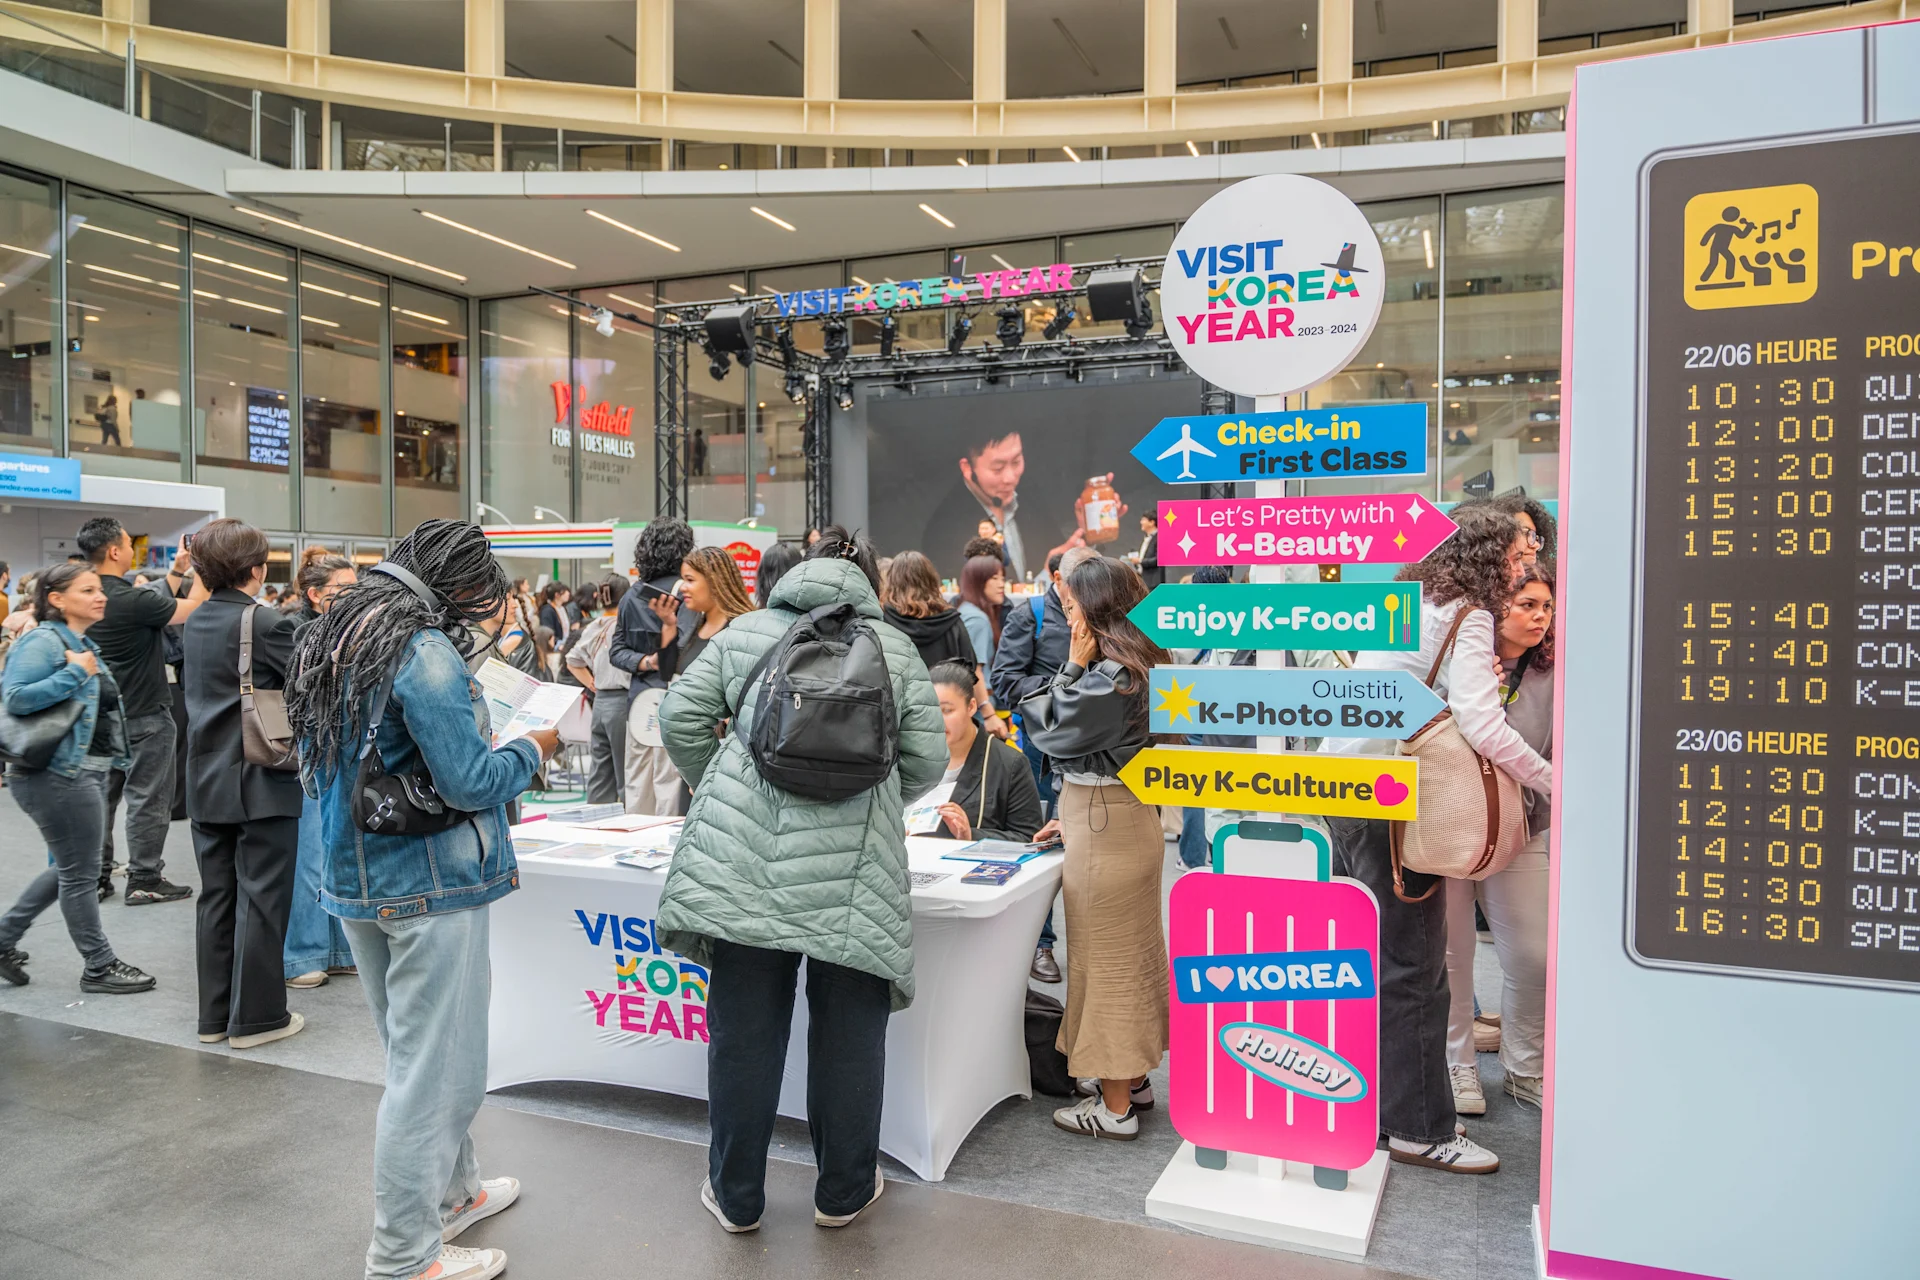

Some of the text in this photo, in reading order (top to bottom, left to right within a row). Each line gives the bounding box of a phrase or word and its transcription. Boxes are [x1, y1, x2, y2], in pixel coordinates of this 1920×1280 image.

[1176, 240, 1283, 278] VISIT
[775, 264, 1074, 317] VISIT KOREA YEAR
[1208, 270, 1360, 310] KOREA
[1176, 308, 1294, 344] YEAR
[1684, 338, 1837, 369] 22/06 HEURE
[1866, 374, 1920, 401] QU
[550, 380, 635, 436] Wstfield
[1218, 414, 1361, 446] Check-in
[586, 434, 602, 453] DES
[603, 437, 635, 459] HALLES
[1240, 446, 1406, 474] First Class
[1198, 501, 1394, 530] Let's Pretty with
[1217, 530, 1373, 561] K-Beauty
[1157, 604, 1375, 636] Enjoy K-Food
[1313, 679, 1403, 702] Ouistiti,
[1199, 701, 1404, 728] K-Photo Box
[1676, 729, 1828, 756] 23/06 HEURE
[1855, 736, 1920, 760] PROG
[1144, 766, 1372, 800] Play K-Culture
[574, 910, 684, 958] VISI
[1191, 962, 1362, 992] I KOREA
[585, 990, 710, 1044] YEAR
[1236, 1030, 1351, 1092] Holiday
